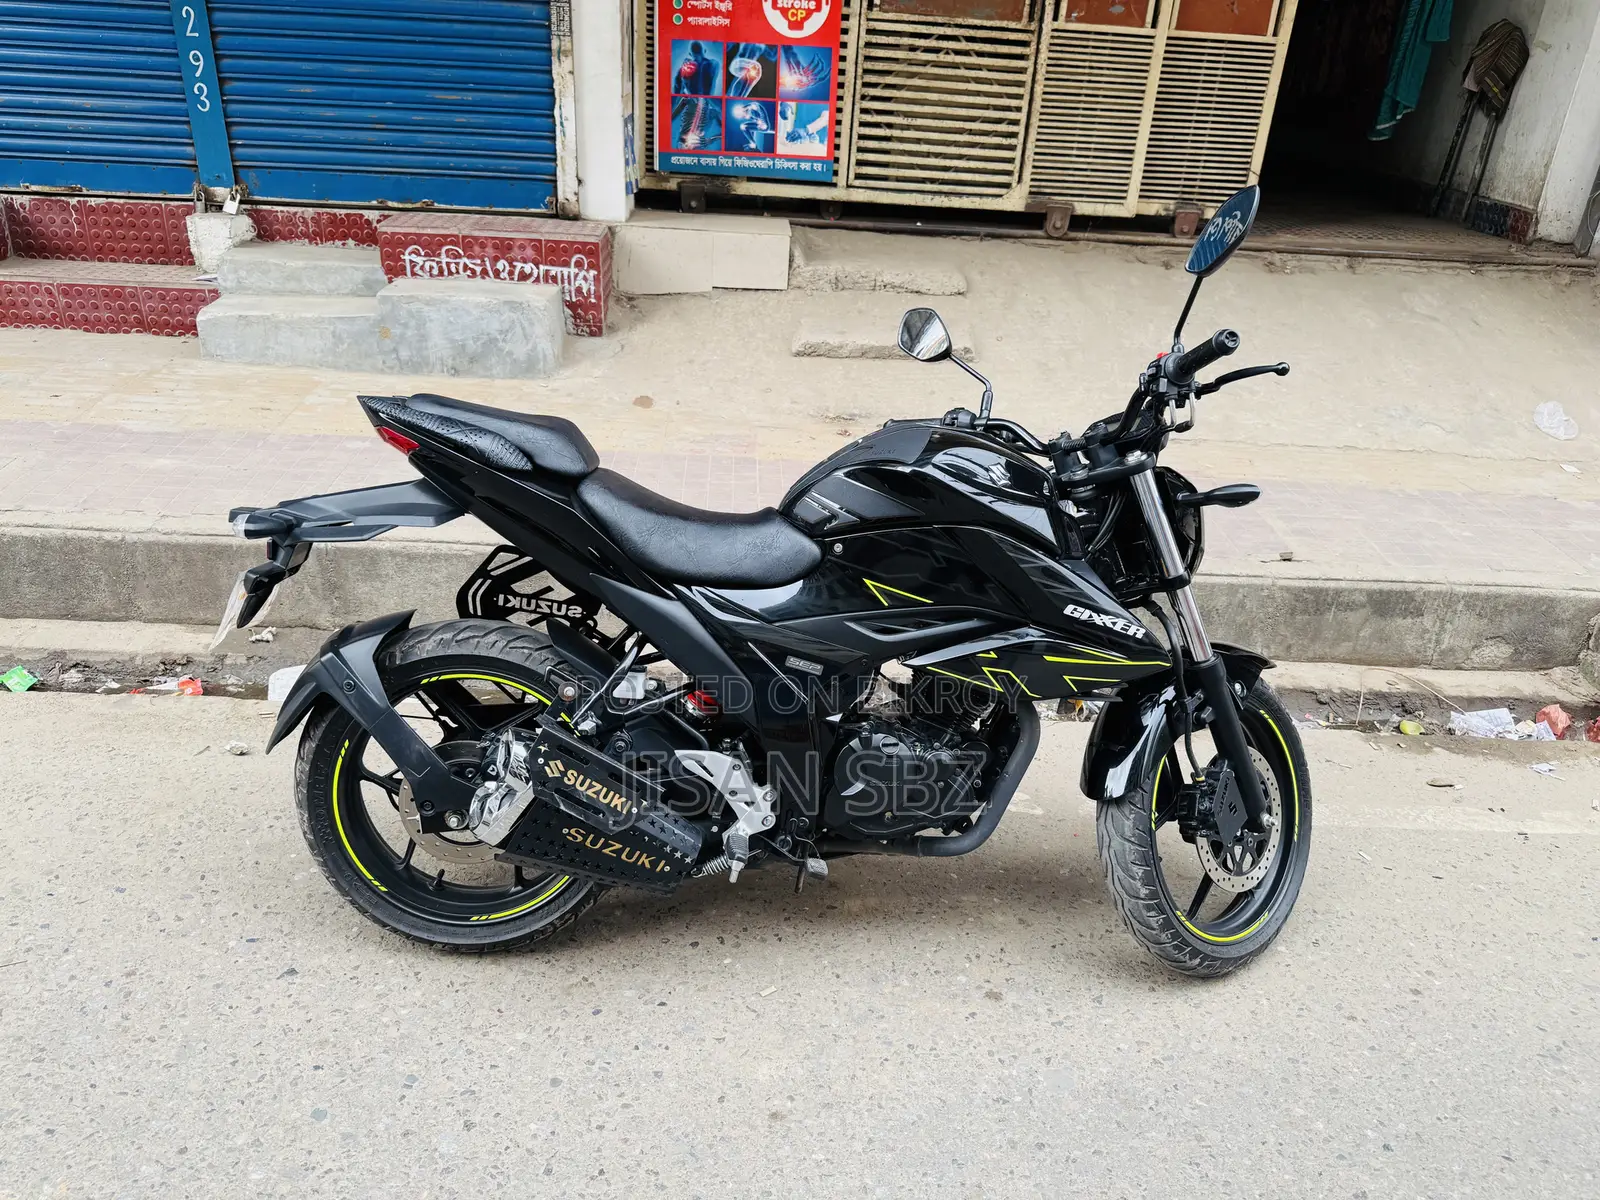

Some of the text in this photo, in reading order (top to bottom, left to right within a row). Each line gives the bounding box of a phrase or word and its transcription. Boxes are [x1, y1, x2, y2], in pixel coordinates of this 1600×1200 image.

[788, 8, 807, 22] CP
[1063, 604, 1146, 639] GIXXER
[788, 657, 821, 671] SEP
[563, 769, 632, 815] SUZUKI
[566, 827, 666, 873] SUZUKI
